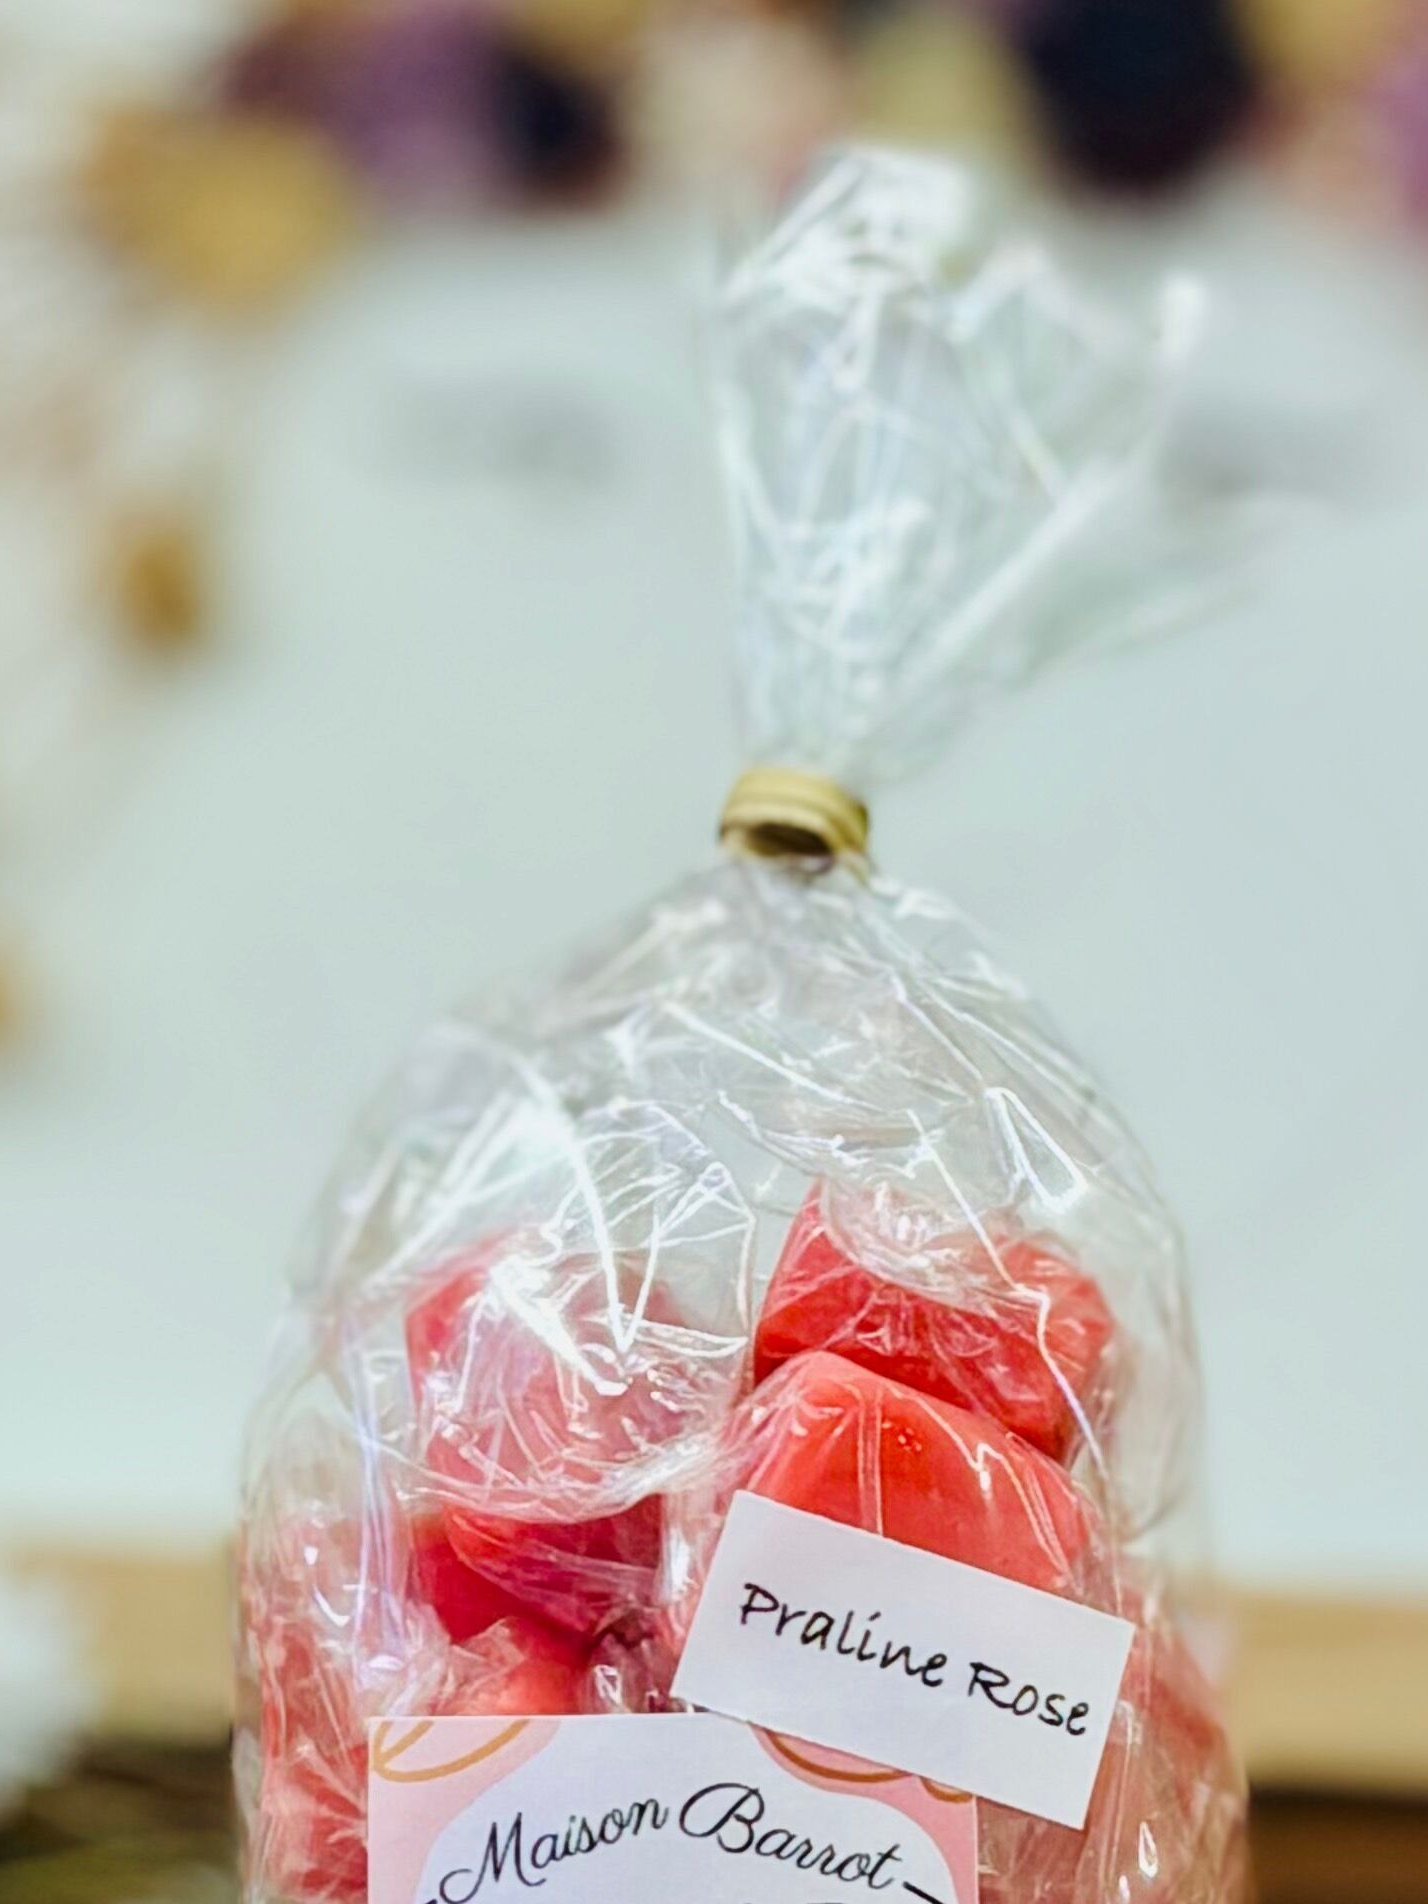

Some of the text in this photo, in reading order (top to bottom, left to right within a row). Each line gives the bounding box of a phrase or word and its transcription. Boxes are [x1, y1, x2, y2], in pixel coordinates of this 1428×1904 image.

[740, 1583, 1090, 1736] Praline Rose
[439, 1782, 901, 1904] Maison Barrot
